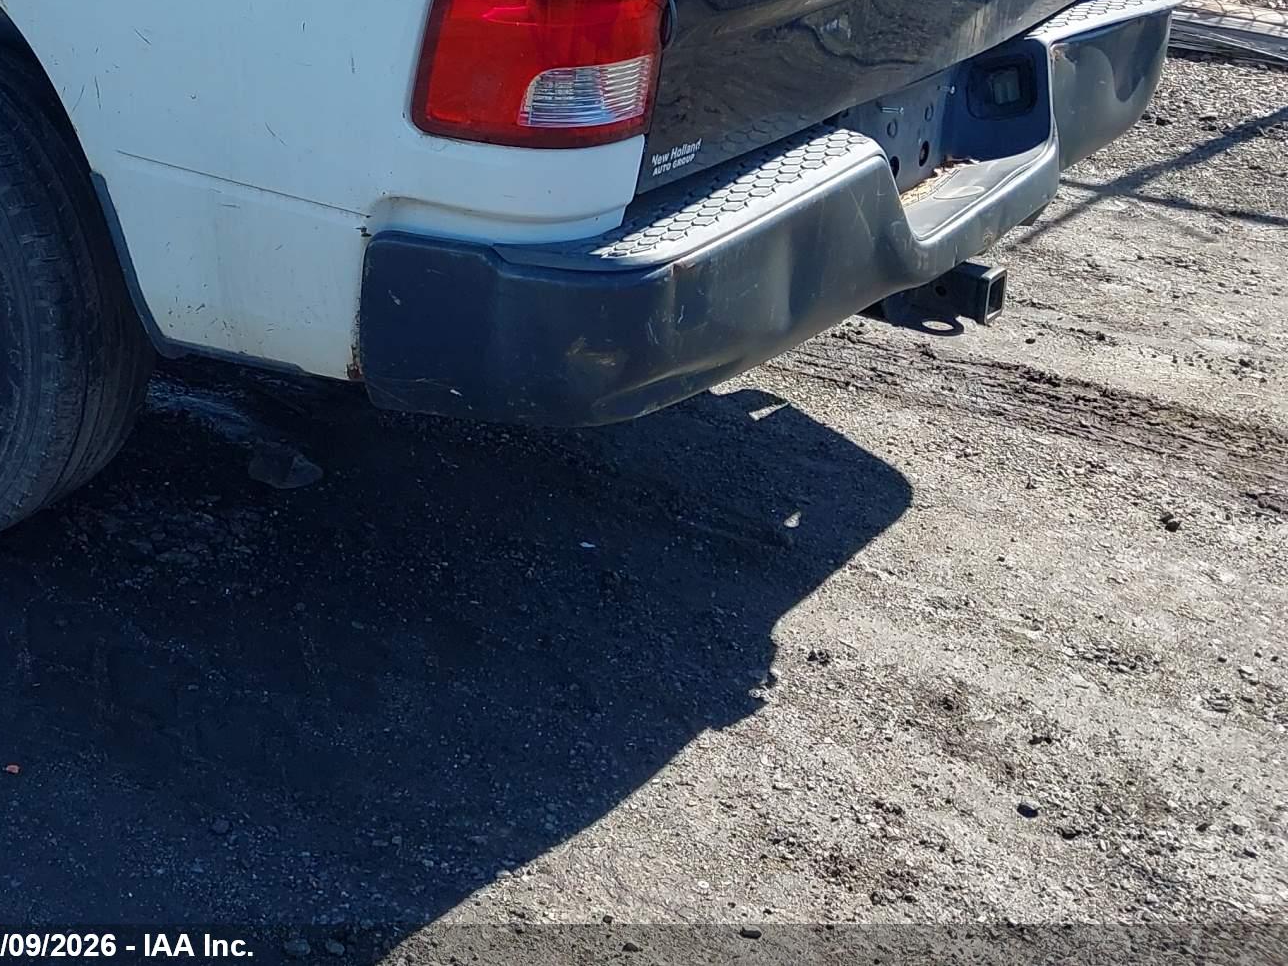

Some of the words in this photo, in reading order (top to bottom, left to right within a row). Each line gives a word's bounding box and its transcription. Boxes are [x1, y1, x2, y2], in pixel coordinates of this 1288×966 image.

[651, 151, 669, 167] New
[670, 137, 702, 161] Holland
[652, 162, 672, 177] AUTO
[672, 153, 696, 170] GROUP
